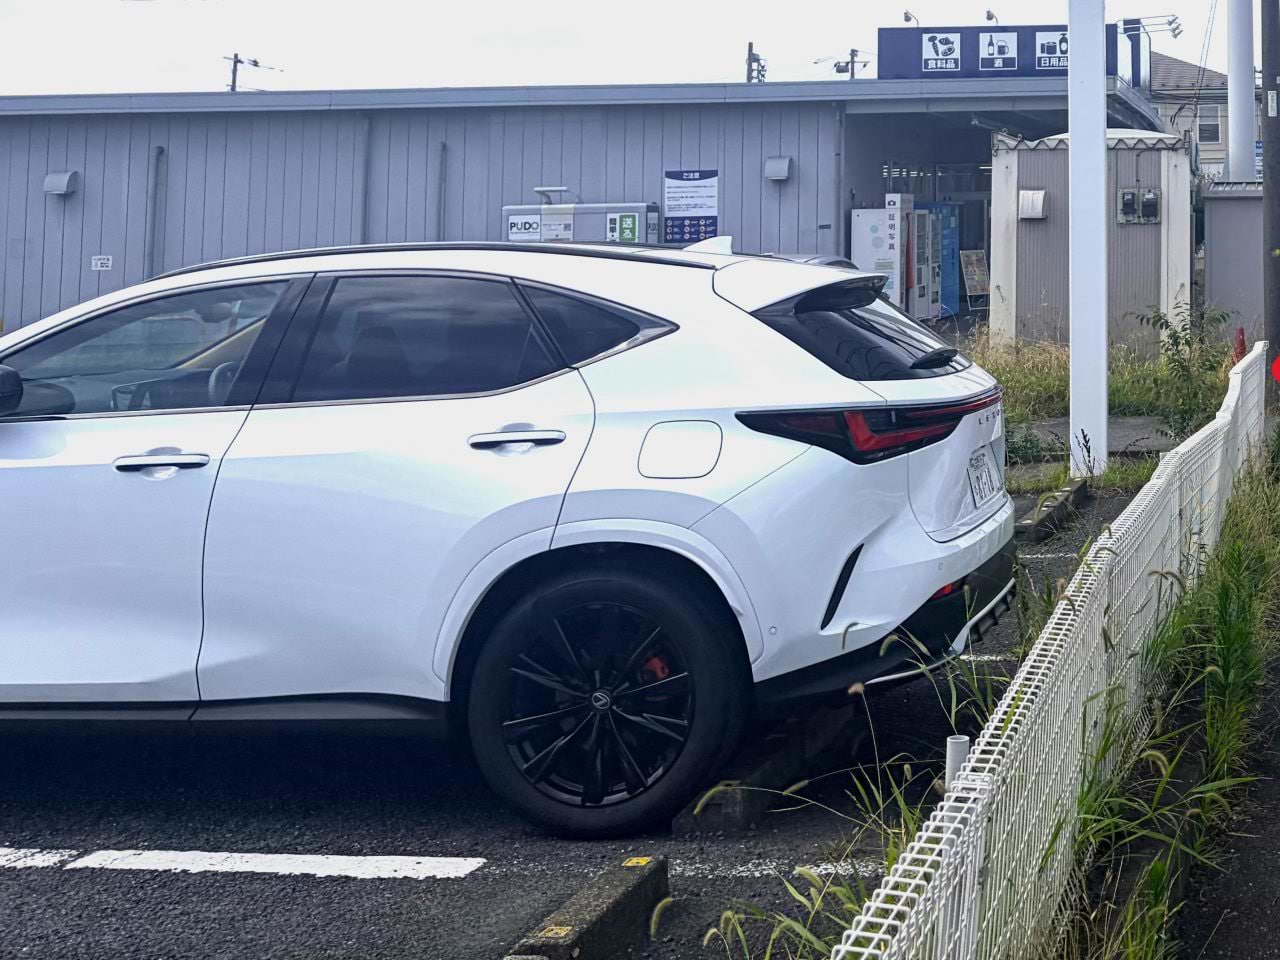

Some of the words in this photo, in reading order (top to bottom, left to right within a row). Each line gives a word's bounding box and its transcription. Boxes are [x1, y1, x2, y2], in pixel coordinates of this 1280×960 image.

[927, 59, 956, 69] 食料品
[993, 59, 1003, 68] 酒
[1041, 57, 1069, 67] 日用品
[509, 221, 540, 231] PUDO
[622, 217, 633, 238] 送る
[888, 213, 896, 251] 証明写真
